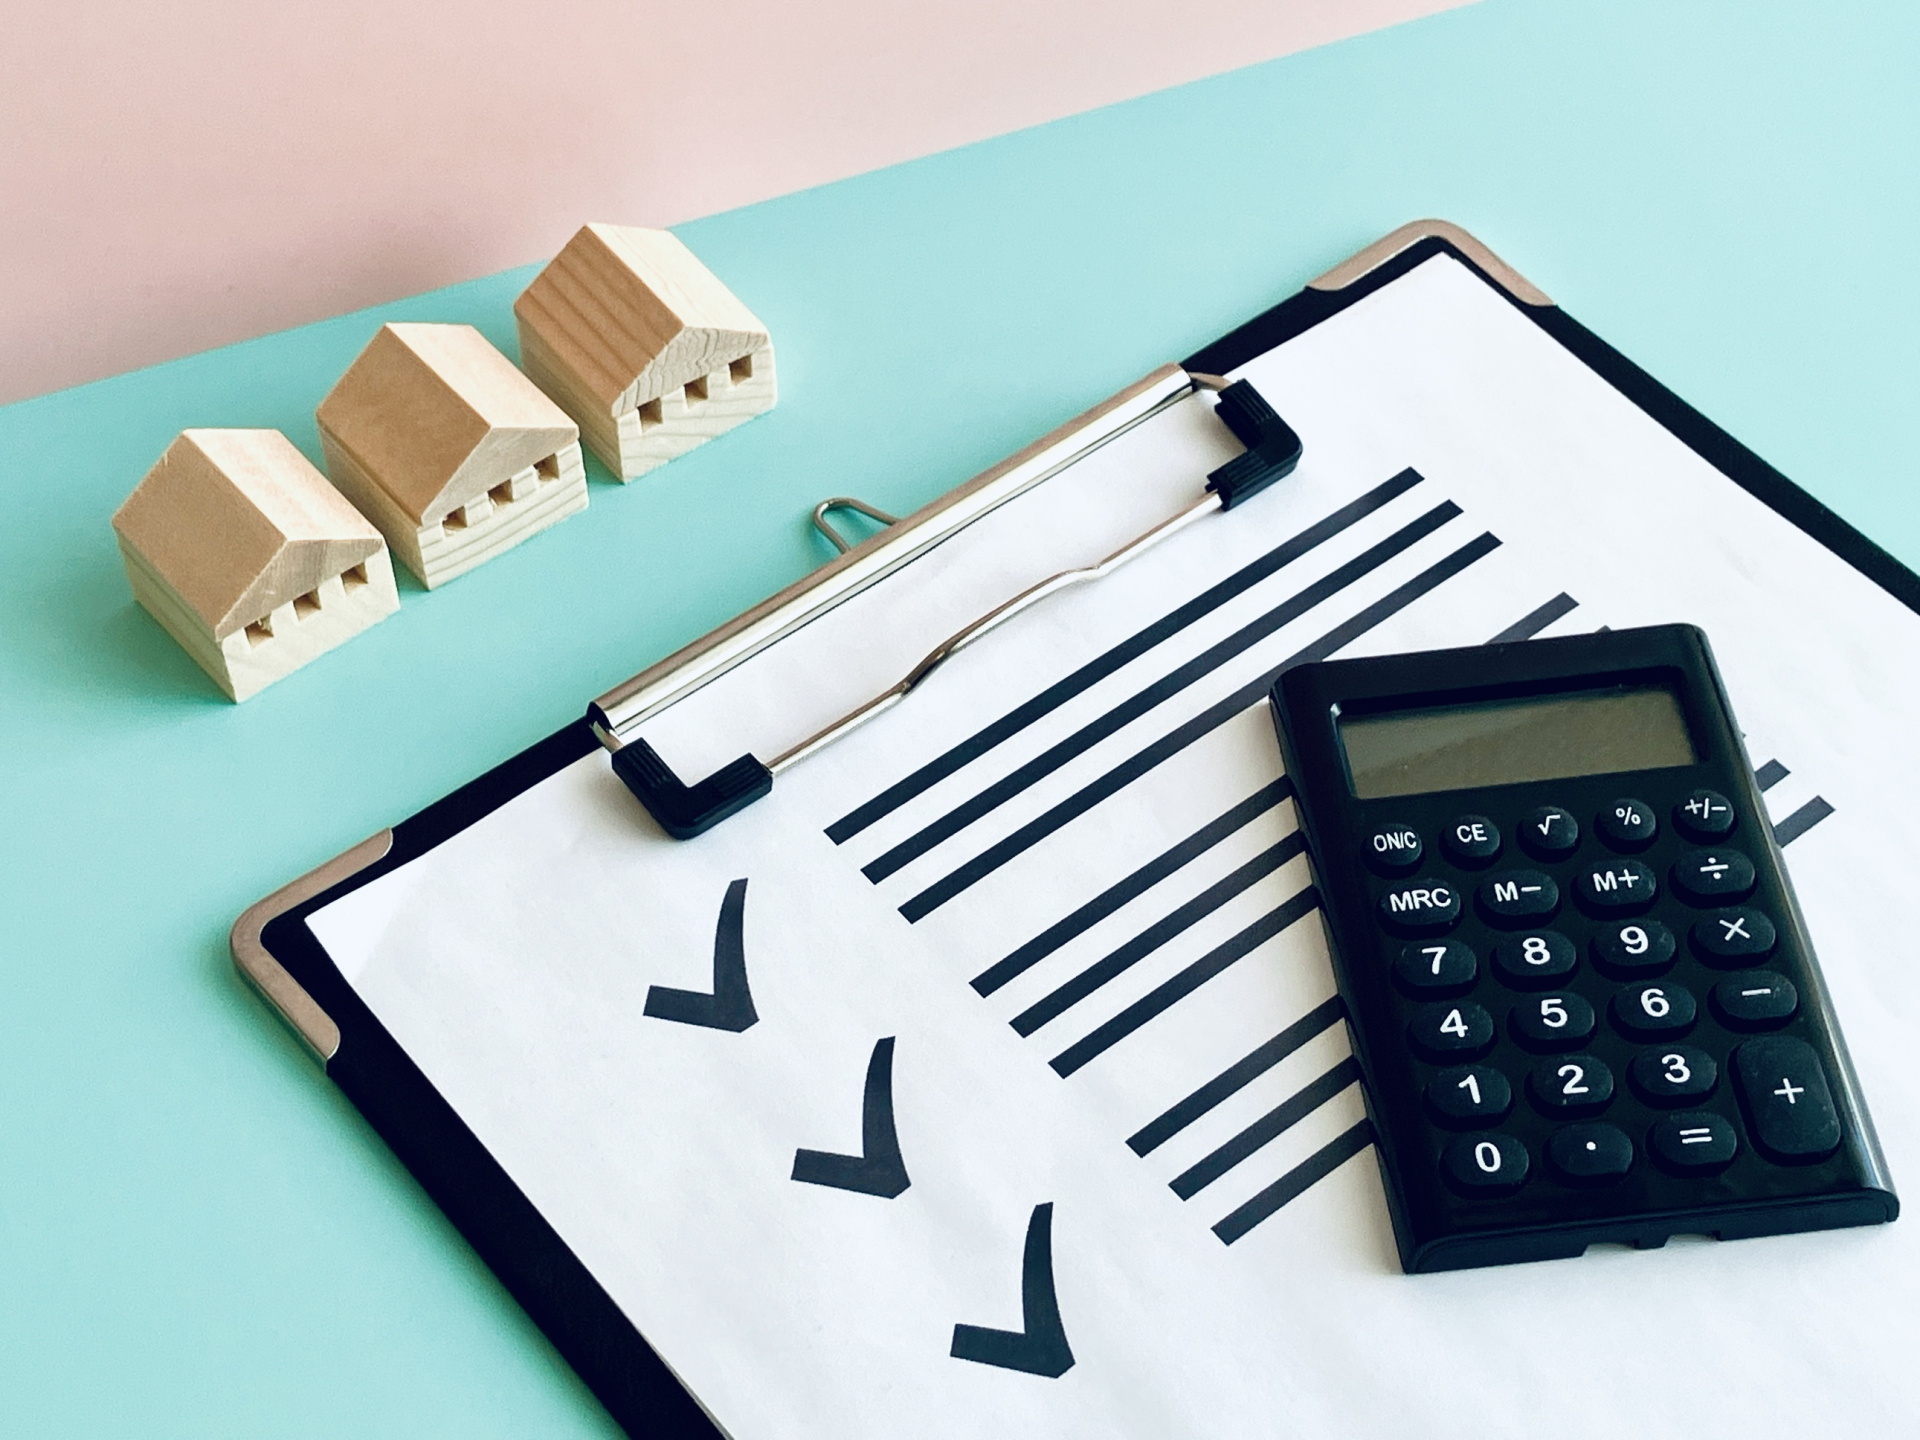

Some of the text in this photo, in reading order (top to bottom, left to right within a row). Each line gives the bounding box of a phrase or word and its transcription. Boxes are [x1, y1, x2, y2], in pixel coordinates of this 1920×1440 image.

[1615, 806, 1642, 826] %
[1373, 831, 1417, 852] ON/C
[1456, 823, 1488, 843] CE
[1592, 868, 1640, 892] M+
[1389, 887, 1452, 912] MRC
[1522, 937, 1551, 965] 8
[1619, 926, 1649, 954] 9
[1421, 946, 1447, 975] 7
[1540, 998, 1568, 1028] 5
[1640, 988, 1670, 1018] 6
[1439, 1008, 1469, 1038] 4
[1557, 1064, 1590, 1095] 2
[1661, 1053, 1691, 1084] 3
[1458, 1074, 1481, 1104] 1
[1773, 1077, 1805, 1105] +
[1679, 1127, 1713, 1144] =
[1474, 1141, 1501, 1173] 0
